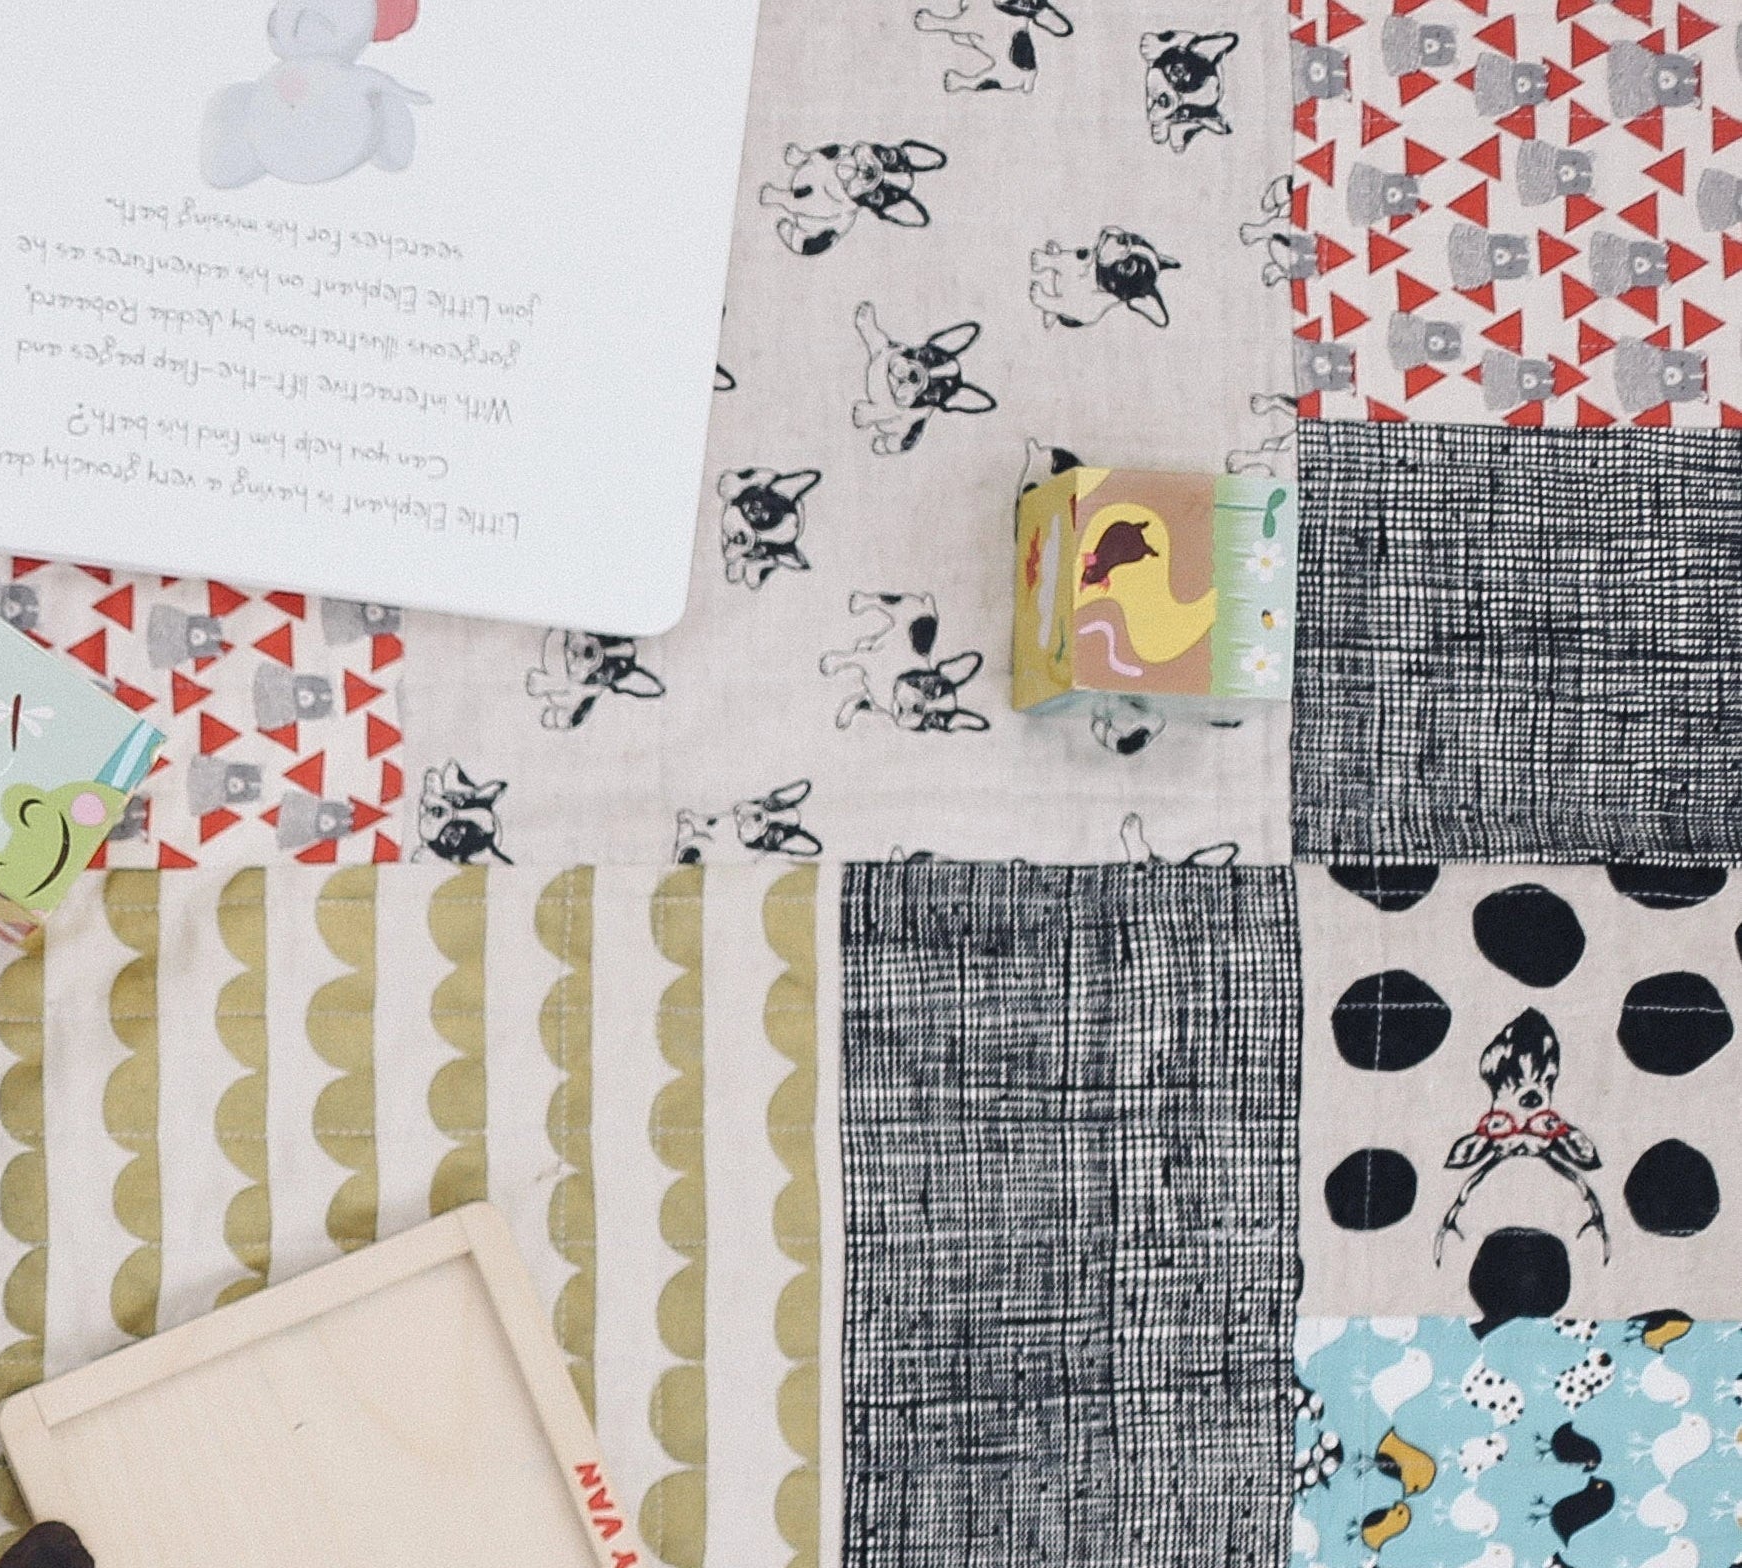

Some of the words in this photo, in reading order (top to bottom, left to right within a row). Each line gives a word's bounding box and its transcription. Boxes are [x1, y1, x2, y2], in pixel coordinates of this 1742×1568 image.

[176, 196, 259, 232] missing
[17, 234, 48, 263] he
[265, 219, 299, 248] his
[305, 227, 343, 257] for
[349, 230, 464, 260] searches
[55, 242, 86, 260] as
[93, 246, 230, 280] adventures
[236, 265, 270, 293] his
[276, 273, 305, 287] on
[311, 278, 418, 314] Elephant
[427, 289, 491, 321] Little
[496, 292, 542, 326] join
[148, 305, 223, 335] Jedda
[229, 308, 256, 340] by
[15, 338, 63, 361] and
[69, 335, 147, 367] pages
[263, 319, 399, 360] illustrations
[406, 334, 521, 371] gorgeous
[318, 374, 448, 413] interactive
[456, 394, 512, 424] With
[66, 401, 149, 440] bath?
[156, 418, 190, 444] his
[196, 425, 241, 456] find
[248, 432, 287, 458] him
[293, 431, 343, 463] help
[350, 440, 390, 462] you
[41, 446, 141, 484] grouchy
[147, 459, 196, 487] very
[396, 452, 450, 480] Can
[206, 476, 223, 492] a
[230, 466, 309, 512] having
[316, 489, 334, 506] is
[341, 495, 448, 531] Elephant
[457, 505, 521, 540] Little
[574, 1461, 624, 1541] VAN
